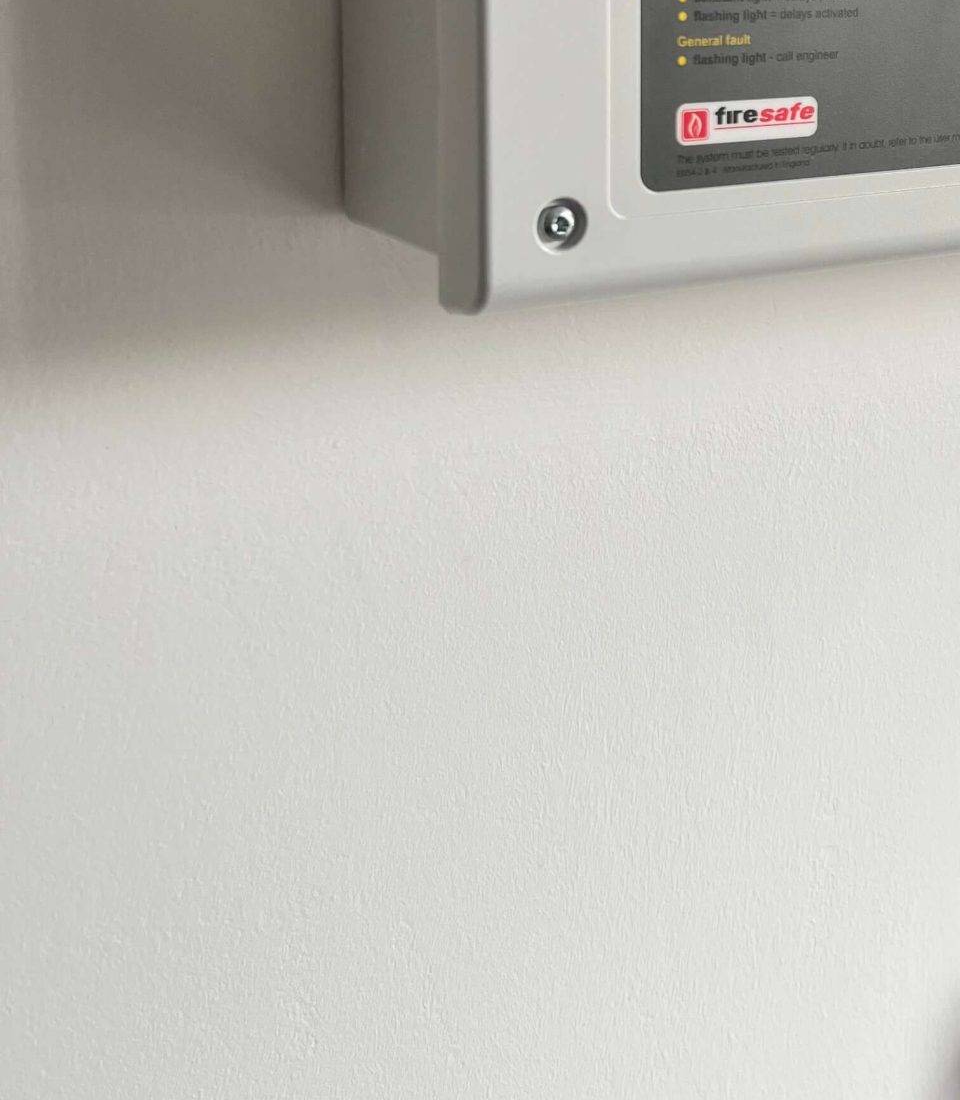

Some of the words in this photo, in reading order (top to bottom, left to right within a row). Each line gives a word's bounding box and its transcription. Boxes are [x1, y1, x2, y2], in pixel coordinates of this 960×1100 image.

[694, 10, 740, 23] flashing
[743, 9, 767, 22] light
[677, 35, 722, 47] General
[726, 34, 751, 46] fault
[693, 53, 739, 66] flashing
[742, 52, 767, 66] light
[715, 102, 815, 125] firesafe
